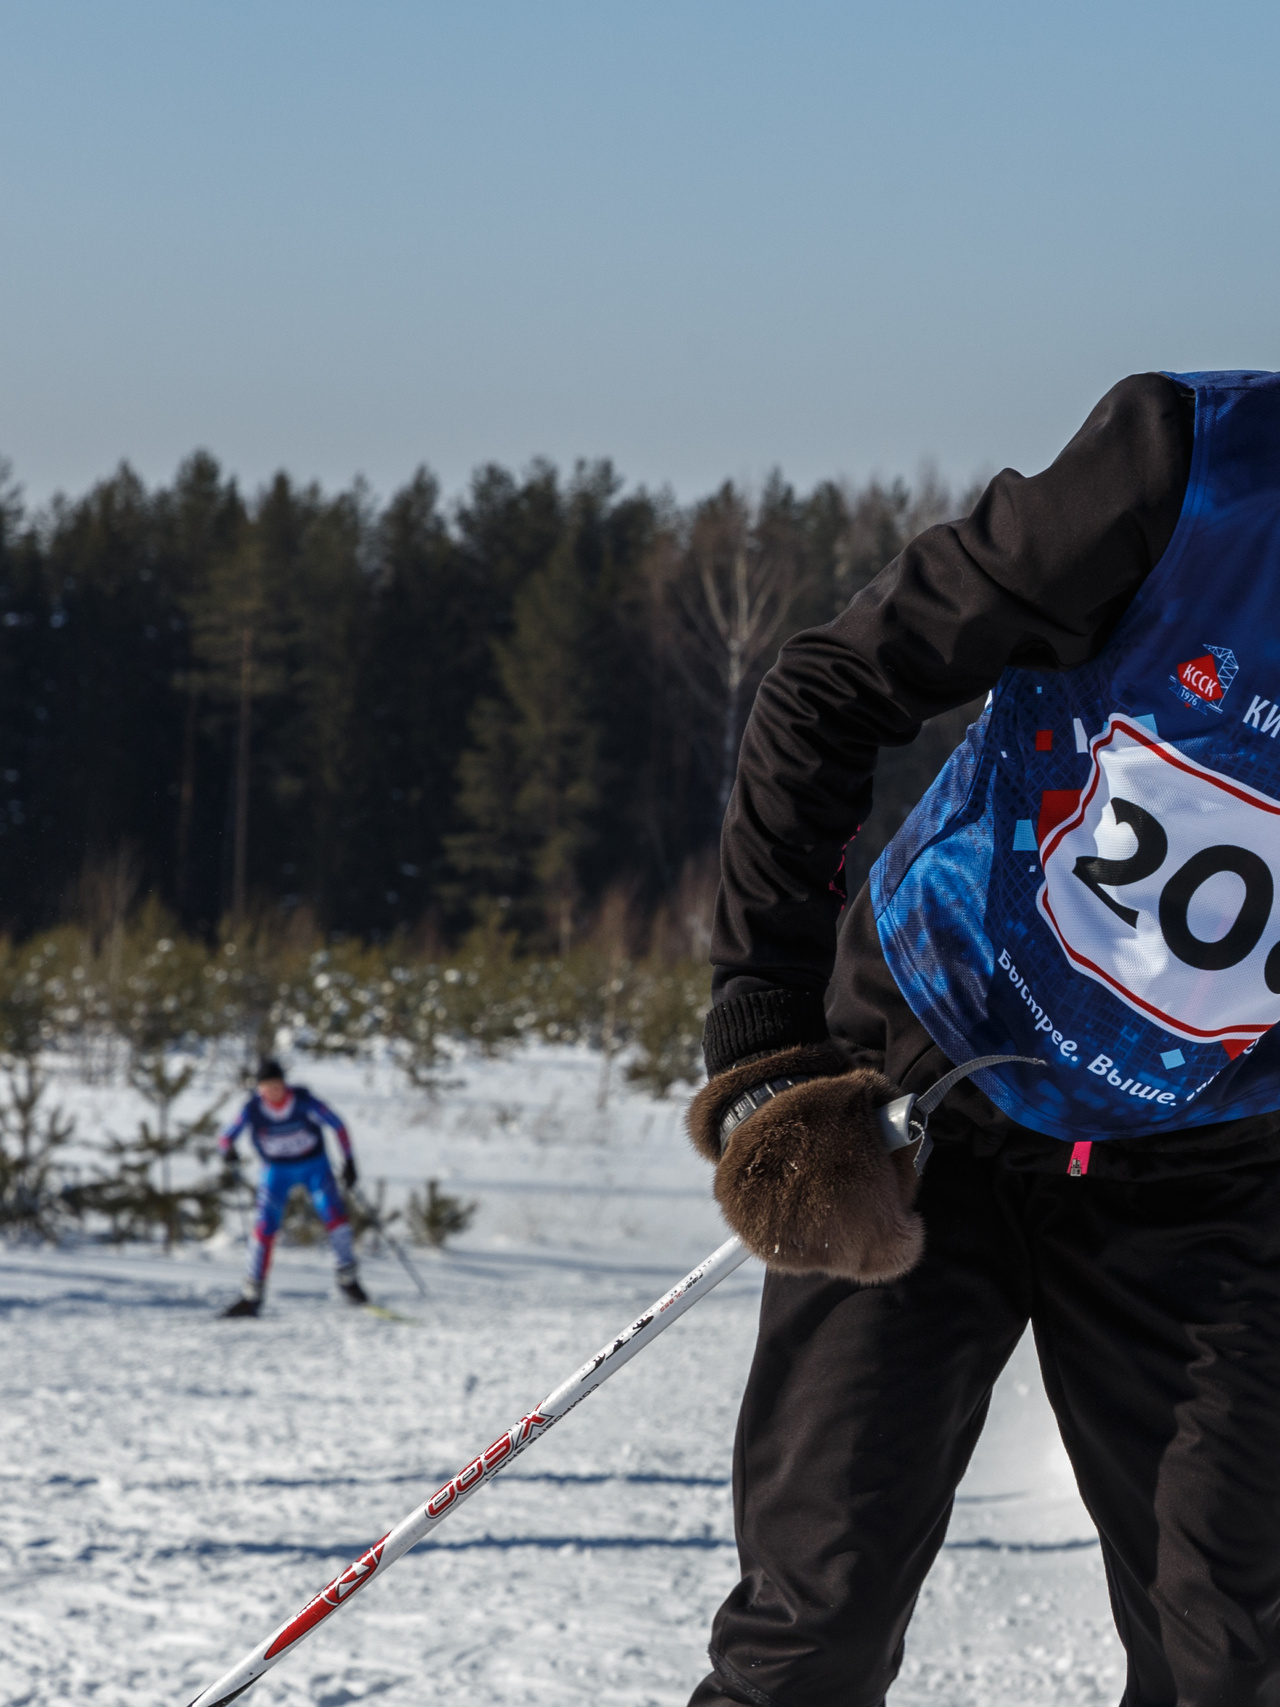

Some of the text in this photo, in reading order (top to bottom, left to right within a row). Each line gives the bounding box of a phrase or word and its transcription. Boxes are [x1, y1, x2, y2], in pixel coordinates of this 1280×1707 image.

[1180, 689, 1198, 706] 1976
[1182, 663, 1218, 698] КССК
[997, 948, 1177, 1107] Быстрее. Выше.
